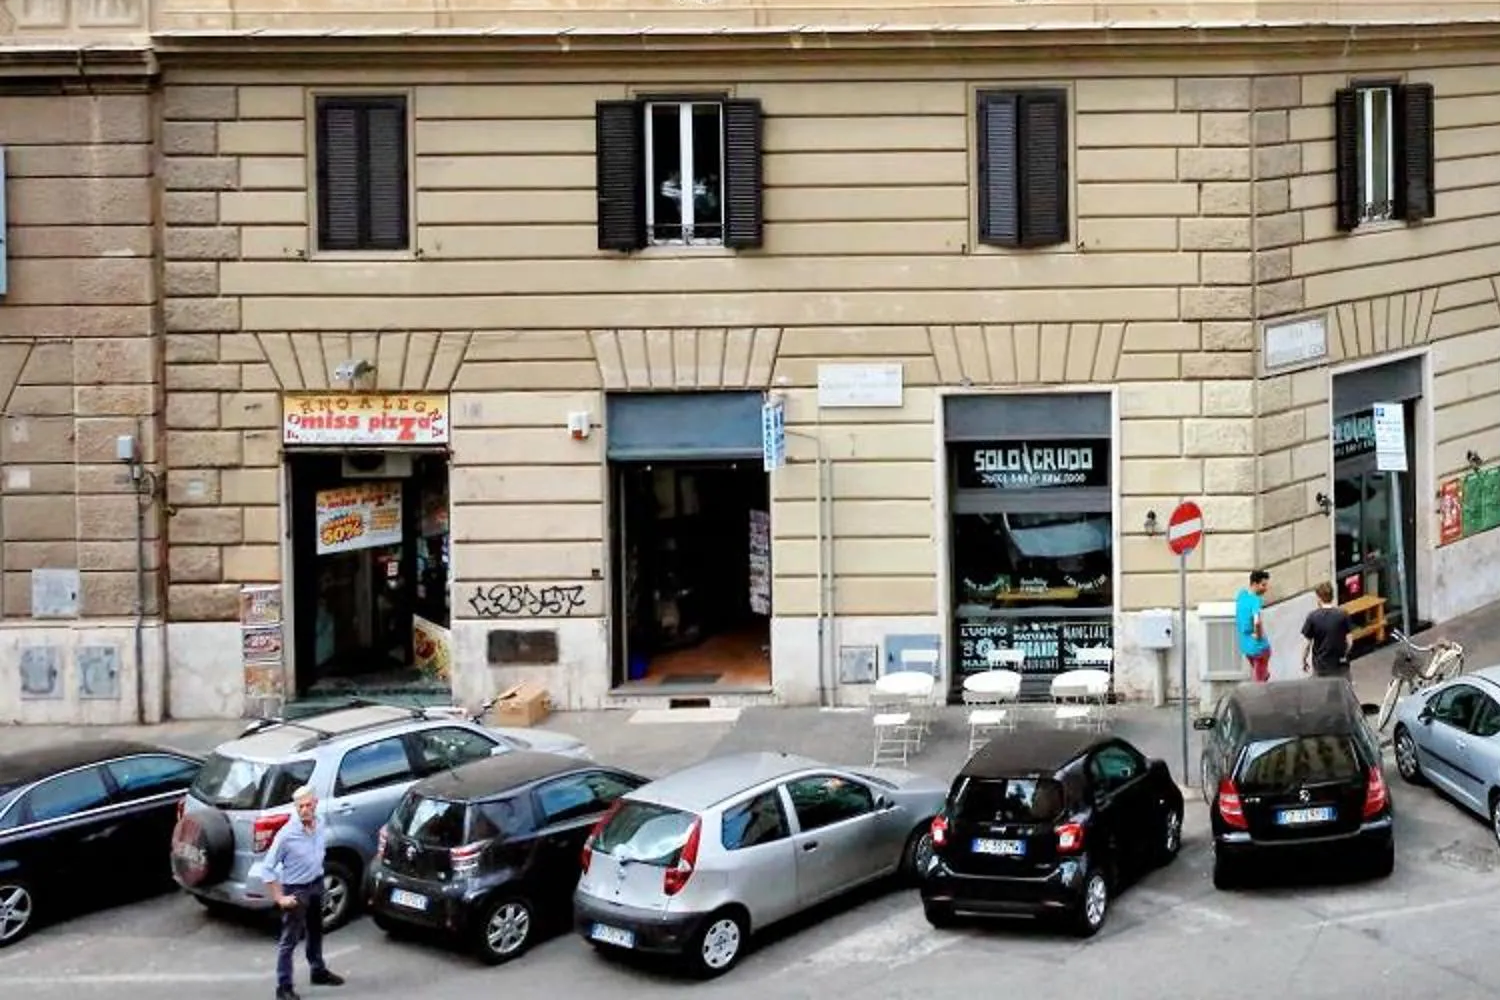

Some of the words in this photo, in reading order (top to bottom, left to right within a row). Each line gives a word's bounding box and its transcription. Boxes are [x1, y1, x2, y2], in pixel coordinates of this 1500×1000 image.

[301, 411, 360, 430] miss
[974, 449, 1020, 471] SOLO
[1032, 447, 1093, 471] CRUDO
